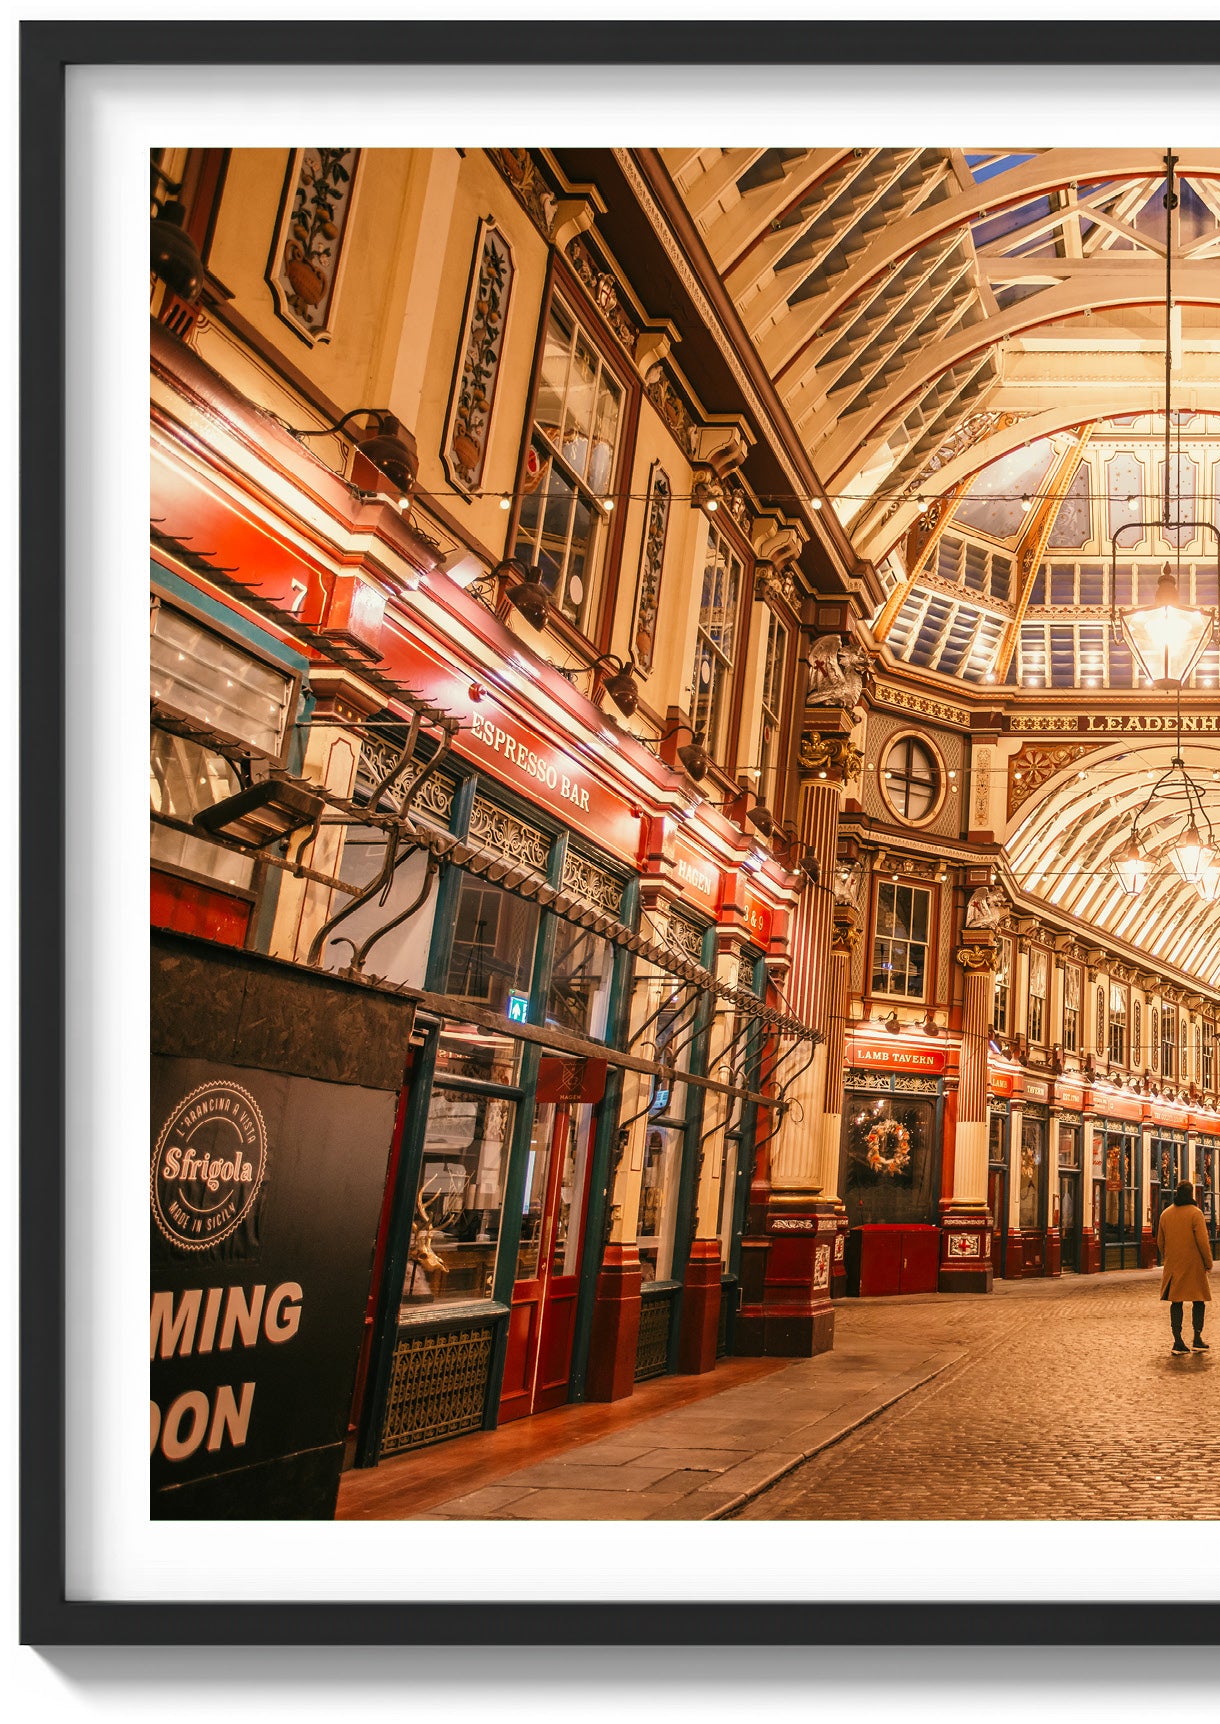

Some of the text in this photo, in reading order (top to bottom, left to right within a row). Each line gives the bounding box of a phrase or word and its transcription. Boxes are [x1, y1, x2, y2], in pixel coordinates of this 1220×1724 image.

[291, 577, 308, 613] 7
[470, 710, 591, 814] ESPRESSO BAR
[679, 859, 712, 896] HAGEN
[857, 1049, 935, 1065] LAMB TAVERN
[232, 1103, 240, 1116] A
[240, 1111, 256, 1144] VISTA
[163, 1147, 253, 1192] Sfrigola
[169, 1201, 236, 1233] MADE IN SICILY
[150, 1381, 256, 1462] ON
